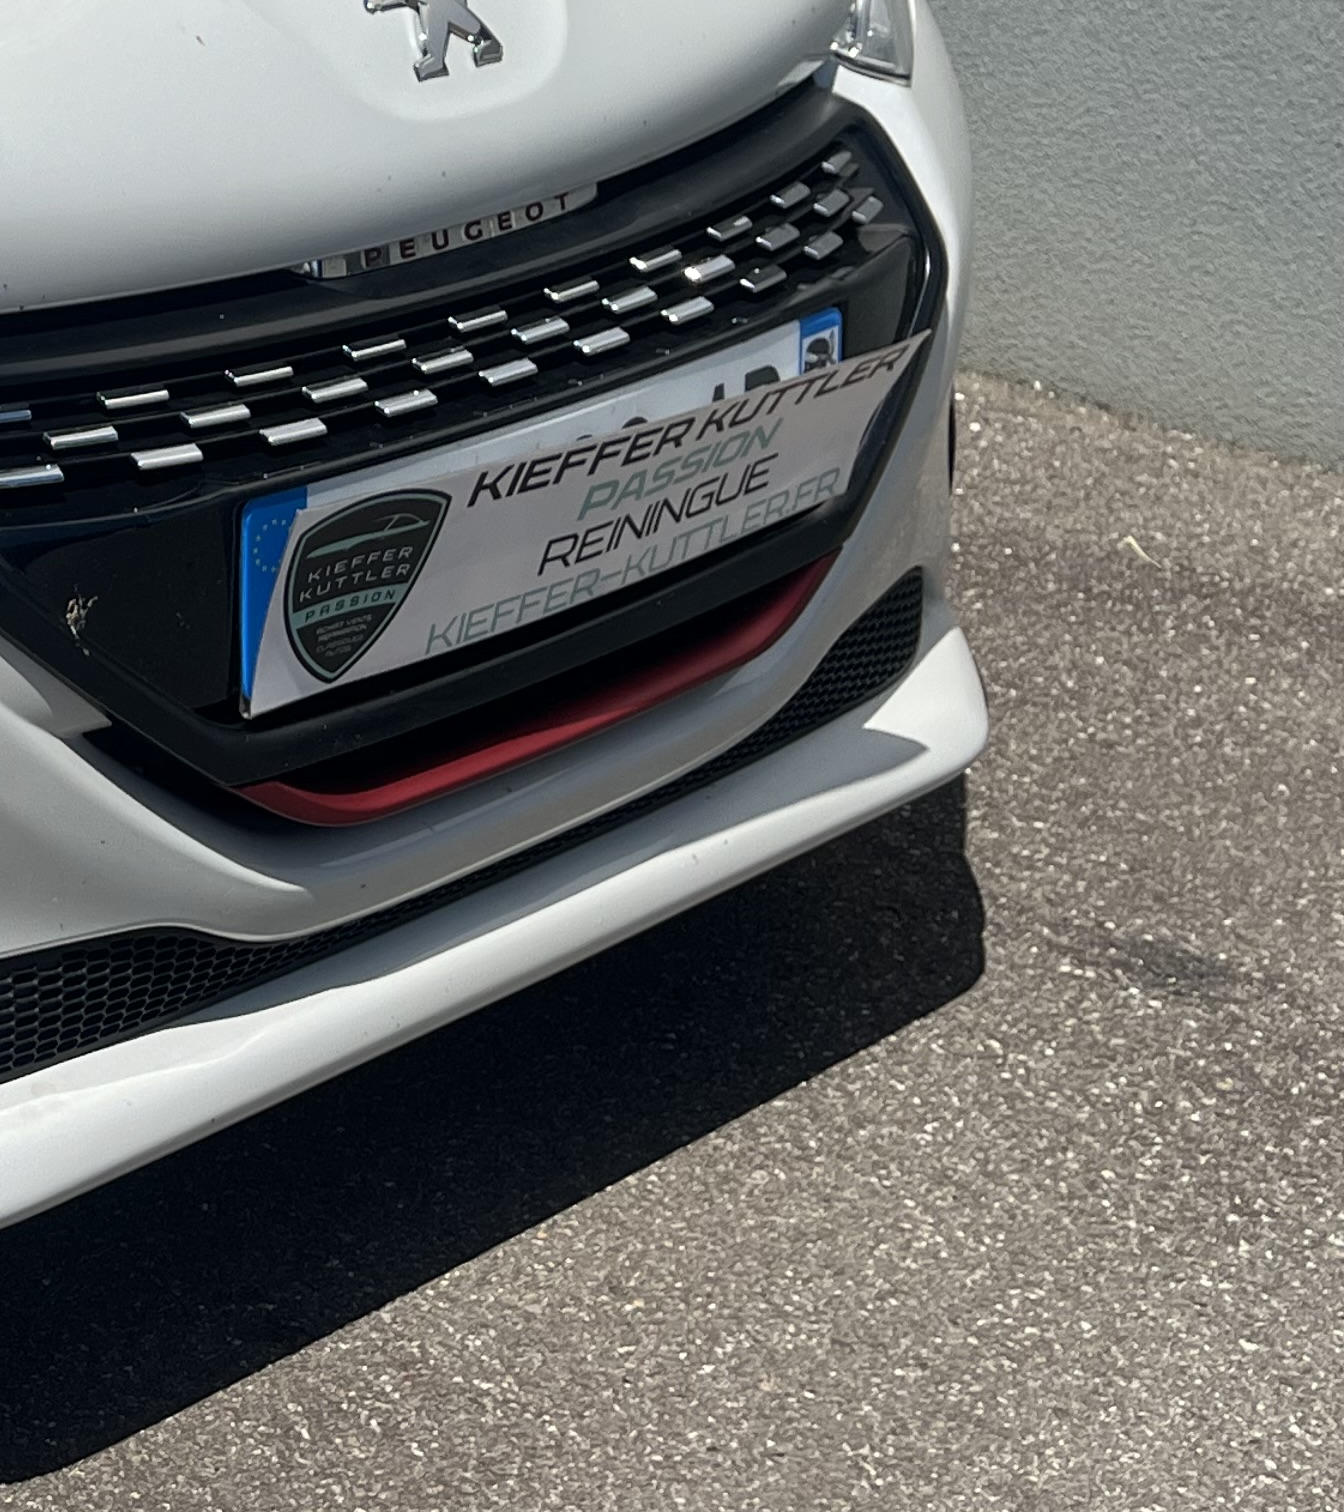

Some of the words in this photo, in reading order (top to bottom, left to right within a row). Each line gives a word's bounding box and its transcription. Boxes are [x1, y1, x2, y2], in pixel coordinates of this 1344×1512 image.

[361, 191, 570, 270] PEUGEOT
[467, 417, 696, 509] KIEFFER
[697, 346, 910, 441] KUTTLER
[576, 418, 783, 522] PASSION
[536, 453, 780, 578] REININGUE
[299, 564, 411, 603] KUTTLER
[305, 589, 396, 622] PASSION
[307, 546, 414, 584] KIEFFER
[424, 466, 841, 657] KIEFFER-KUTTLER.FR
